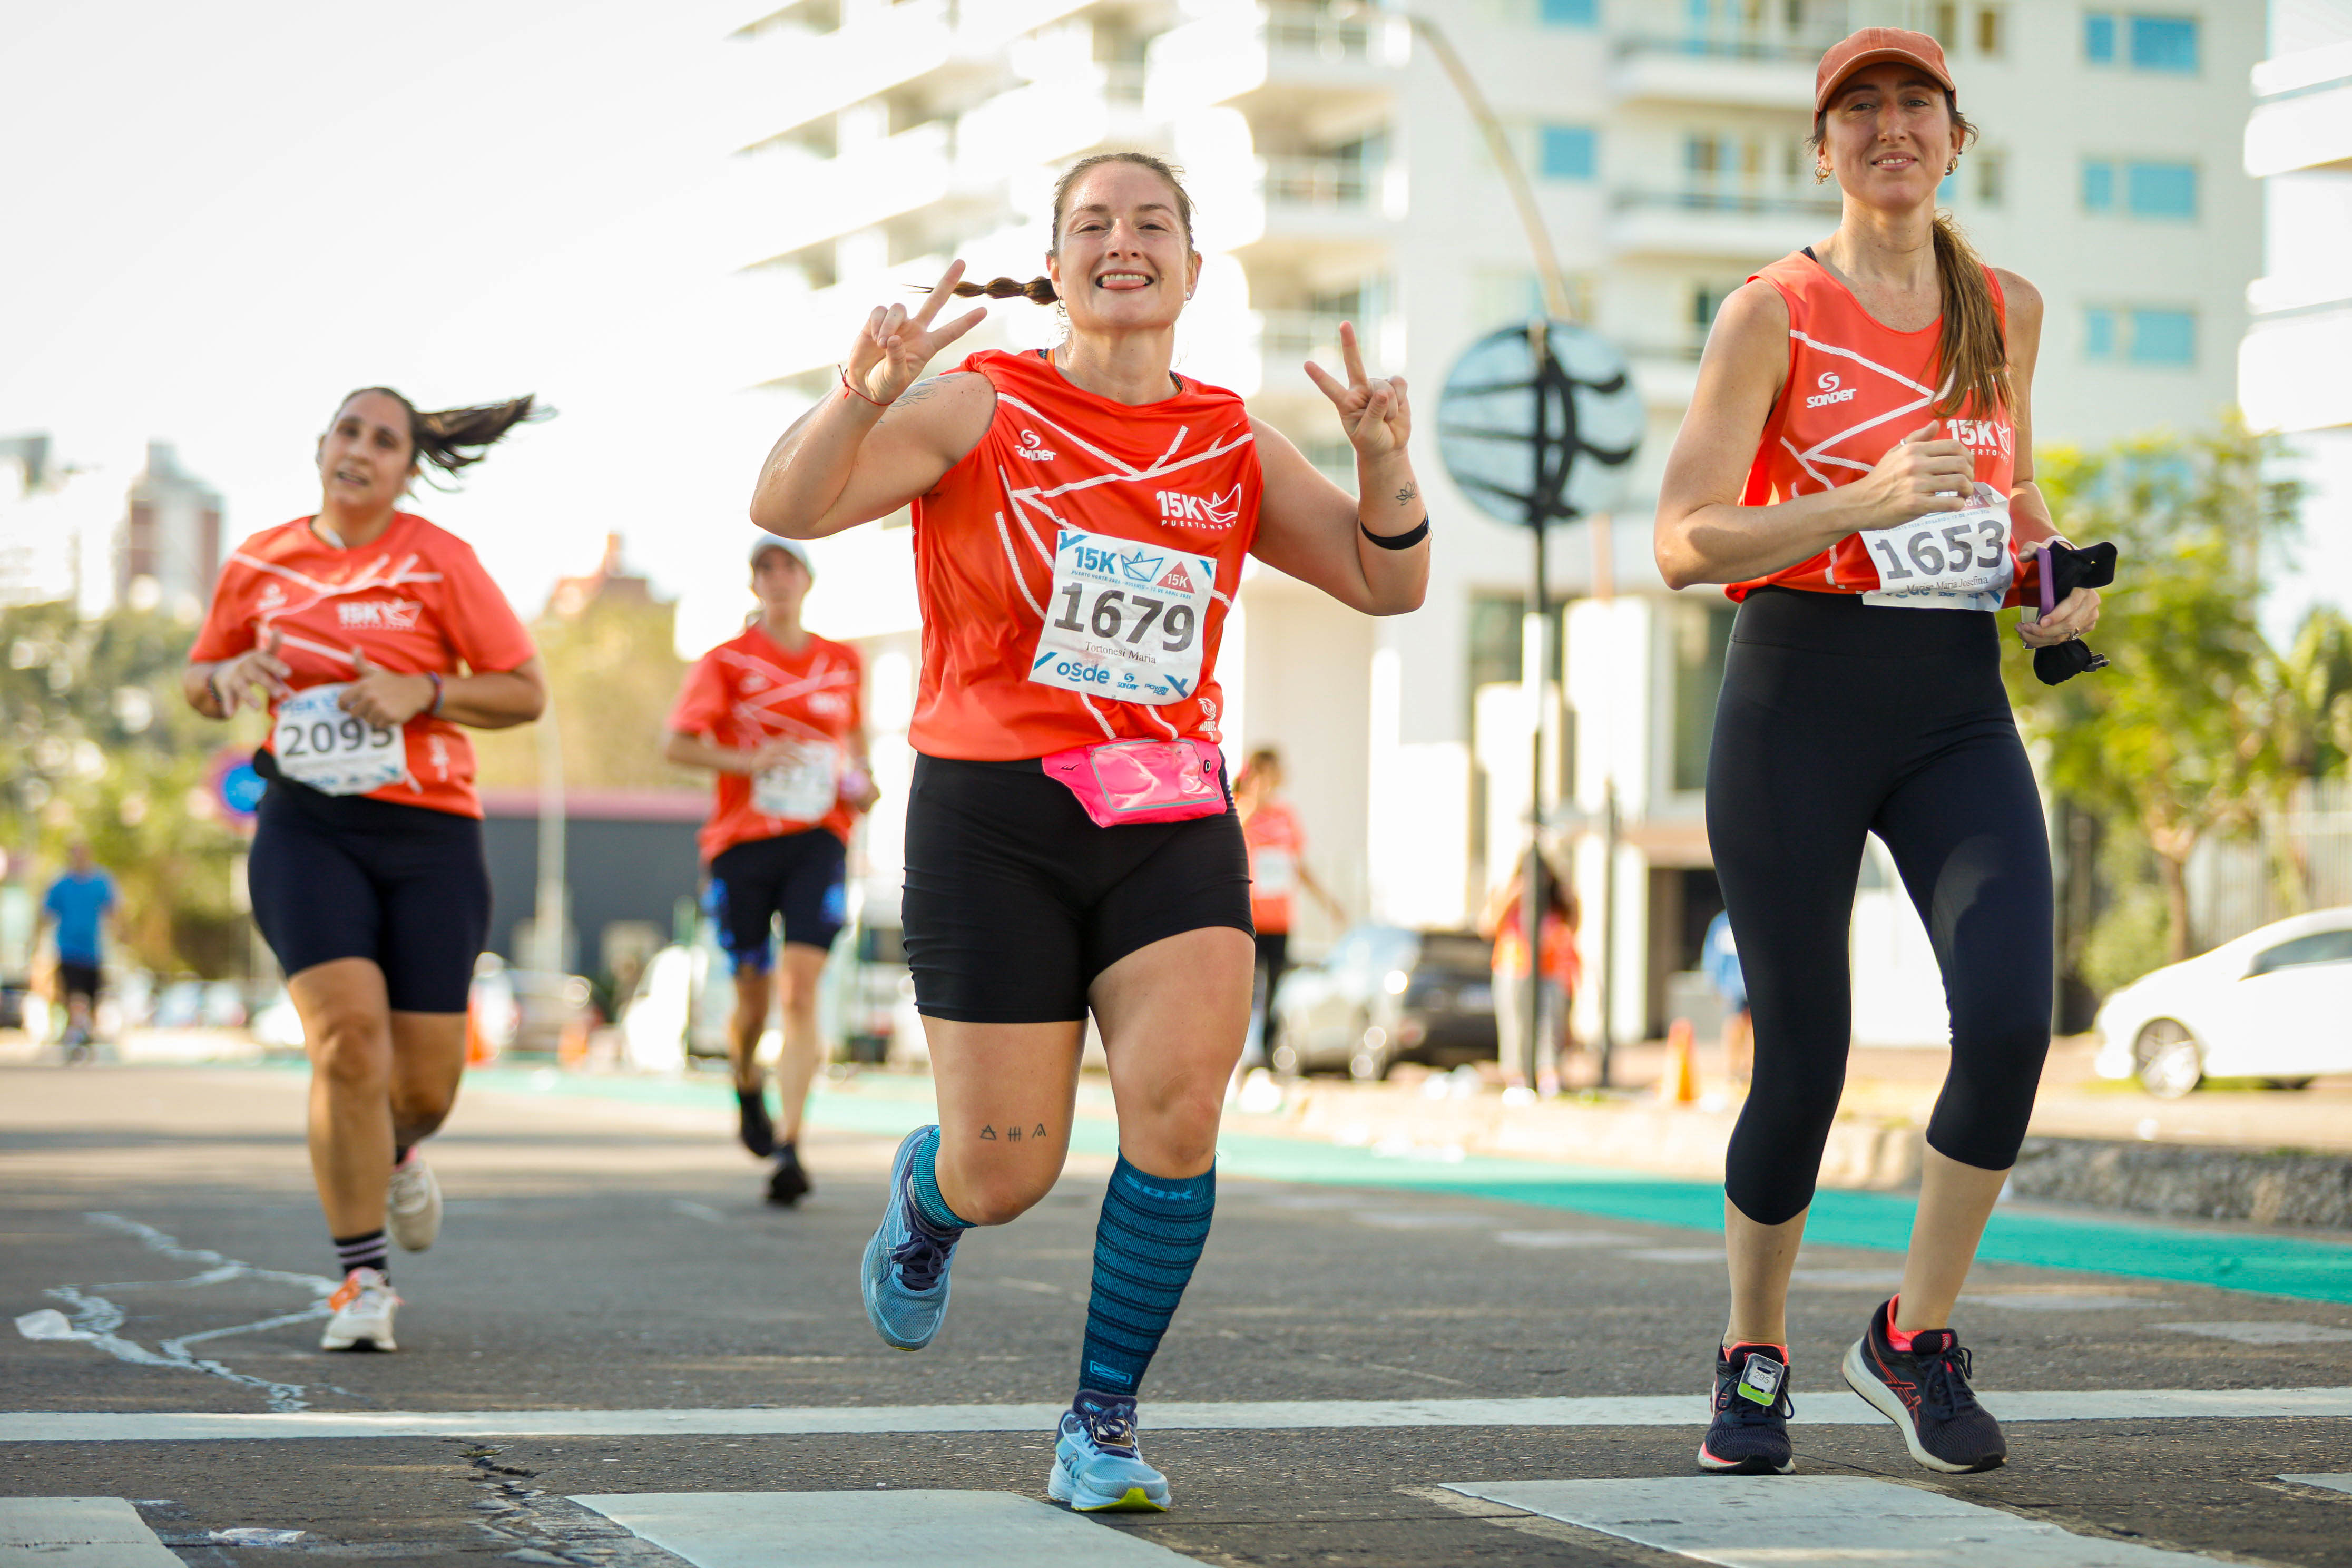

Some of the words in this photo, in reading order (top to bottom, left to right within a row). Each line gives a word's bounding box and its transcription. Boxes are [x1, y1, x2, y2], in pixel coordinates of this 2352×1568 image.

[1946, 419, 1997, 446] 15K
[1156, 491, 1204, 521] 15K
[1162, 520, 1206, 529] PUERTO
[1210, 521, 1236, 530] NORT
[1074, 546, 1117, 574] 15K
[1875, 520, 2005, 580] 1653
[1071, 570, 1091, 578] PUERTO
[1168, 573, 1189, 589] 15K
[1958, 576, 1989, 587] Josefina
[1054, 582, 1195, 652] 1679
[1085, 641, 1126, 658] Tortonesi
[1129, 649, 1157, 664] Maria
[1057, 662, 1110, 684] osde
[1144, 683, 1169, 692] POWER
[282, 718, 393, 756] 2095
[1753, 1371, 1770, 1384] 295
